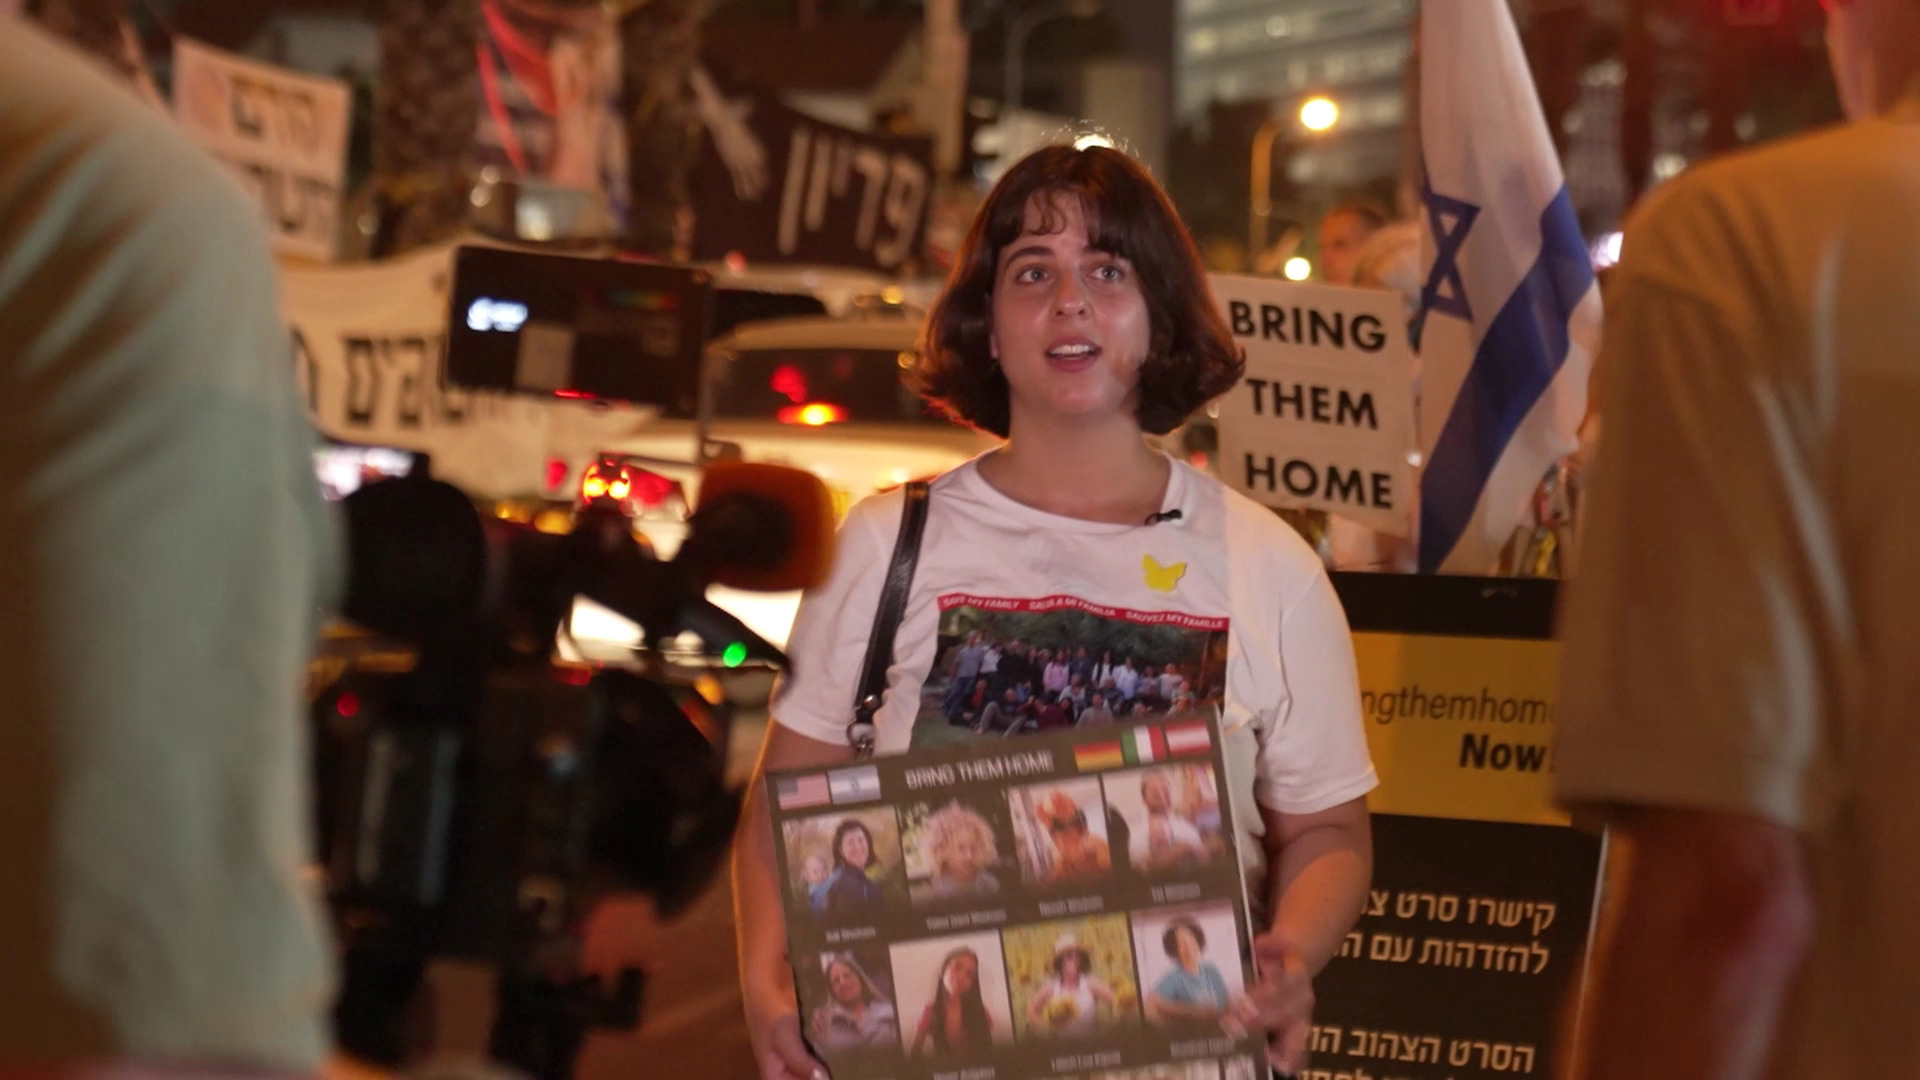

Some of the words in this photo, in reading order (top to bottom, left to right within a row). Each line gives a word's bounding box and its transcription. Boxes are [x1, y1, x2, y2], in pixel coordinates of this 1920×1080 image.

[1228, 301, 1387, 353] BRING
[1246, 378, 1379, 430] THEM
[1244, 453, 1393, 509] HOME
[984, 598, 1020, 609] FAMILY
[1360, 684, 1552, 725] ngthemhom
[904, 763, 956, 790] BRING
[956, 756, 1004, 783] THEM
[1004, 749, 1056, 777] HOME
[1458, 732, 1552, 773] Now
[1395, 891, 1461, 923] סרט
[1467, 898, 1557, 937] קישרו
[1369, 934, 1414, 963] עם
[1417, 940, 1550, 975] להזדהות
[1346, 1029, 1443, 1065] הצהוב
[1448, 1038, 1537, 1074] הסרט
